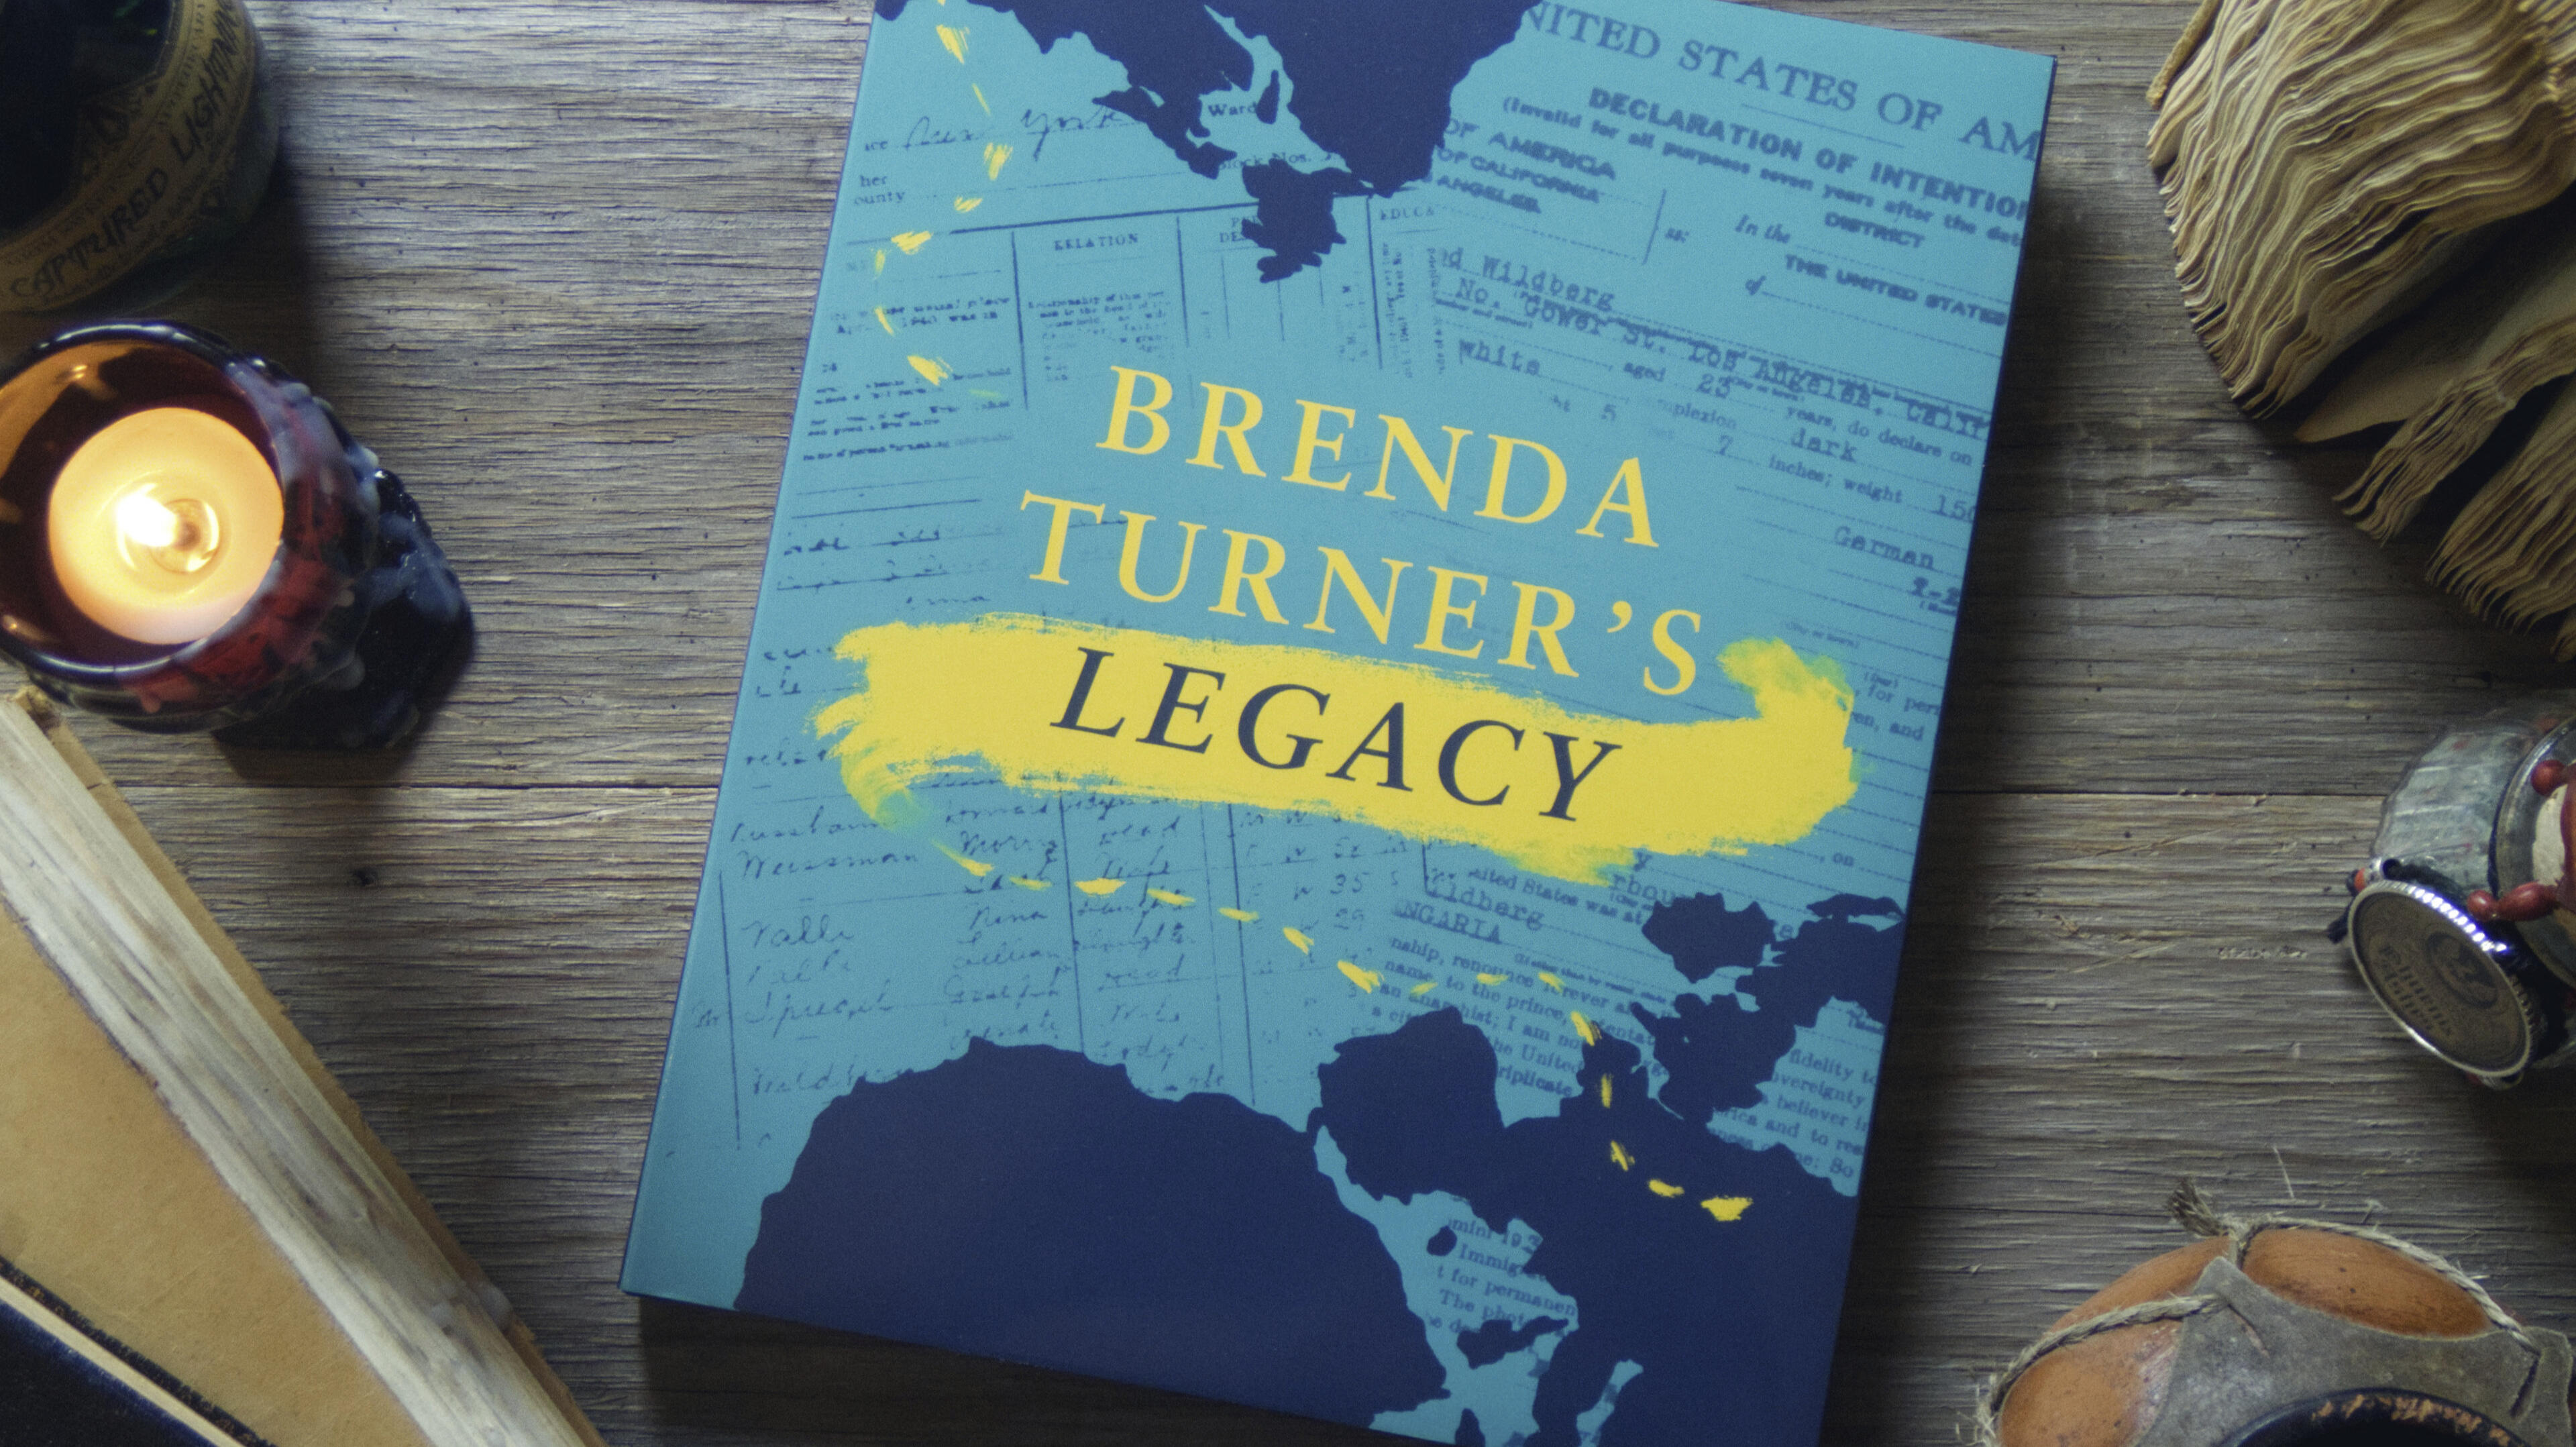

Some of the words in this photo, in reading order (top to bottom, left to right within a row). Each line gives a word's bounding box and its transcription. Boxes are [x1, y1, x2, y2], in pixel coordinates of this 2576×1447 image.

[1678, 39, 1858, 111] STATES
[1877, 93, 1943, 131] OF
[1208, 101, 1258, 117] Ward
[1588, 87, 1803, 162] DECLARATION
[1815, 148, 1859, 174] OF
[1487, 131, 1616, 180] AMERICA
[1502, 96, 1582, 129] (Invalid
[1591, 119, 1619, 138] for
[1627, 132, 1656, 149] all
[1662, 142, 1750, 175] purposes
[1760, 168, 1814, 191] seven
[1821, 184, 1875, 207] years
[1884, 199, 1935, 223] after
[1943, 213, 1978, 235] the
[1470, 156, 1599, 203] CALIFORNIA
[1054, 233, 1138, 252] RELATION
[1735, 214, 1758, 235] In
[1764, 223, 1791, 244] the
[1824, 211, 1925, 248] DISTRICT
[1454, 277, 1501, 310] No.
[1482, 255, 1615, 313] Wildberg
[1745, 276, 1767, 296] of
[1785, 254, 1829, 279] THE
[1835, 270, 1919, 302] UNITED
[1925, 294, 2009, 327] STATES
[1458, 339, 1541, 376] white
[1786, 405, 1837, 433] years,
[1847, 421, 1870, 438] do
[1878, 427, 1943, 458] declare
[1949, 449, 1973, 467] on
[1095, 365, 1659, 548] BRENDA
[1790, 427, 1858, 464] dark
[1768, 453, 1833, 488] inches;
[1843, 478, 1904, 504] weight
[1834, 525, 1935, 570] German
[1868, 683, 1894, 704] for
[1049, 646, 1623, 822] LEGACY
[1889, 722, 1925, 742] and
[1521, 877, 1579, 906] States
[1585, 900, 1619, 918] was
[1621, 910, 1643, 926] at
[1384, 960, 1433, 981] name
[1446, 974, 1465, 992] to
[1471, 983, 1502, 1002] the
[1506, 995, 1567, 1026] prince,
[1508, 1015, 1517, 1032] I
[1522, 1024, 1550, 1042] am
[1789, 1049, 1858, 1080] fidelity
[1777, 1093, 1849, 1129] believer
[1764, 1118, 1801, 1138] and
[1811, 1130, 1829, 1148] to
[1450, 1267, 1478, 1288] for
[1440, 1288, 1475, 1312] The
